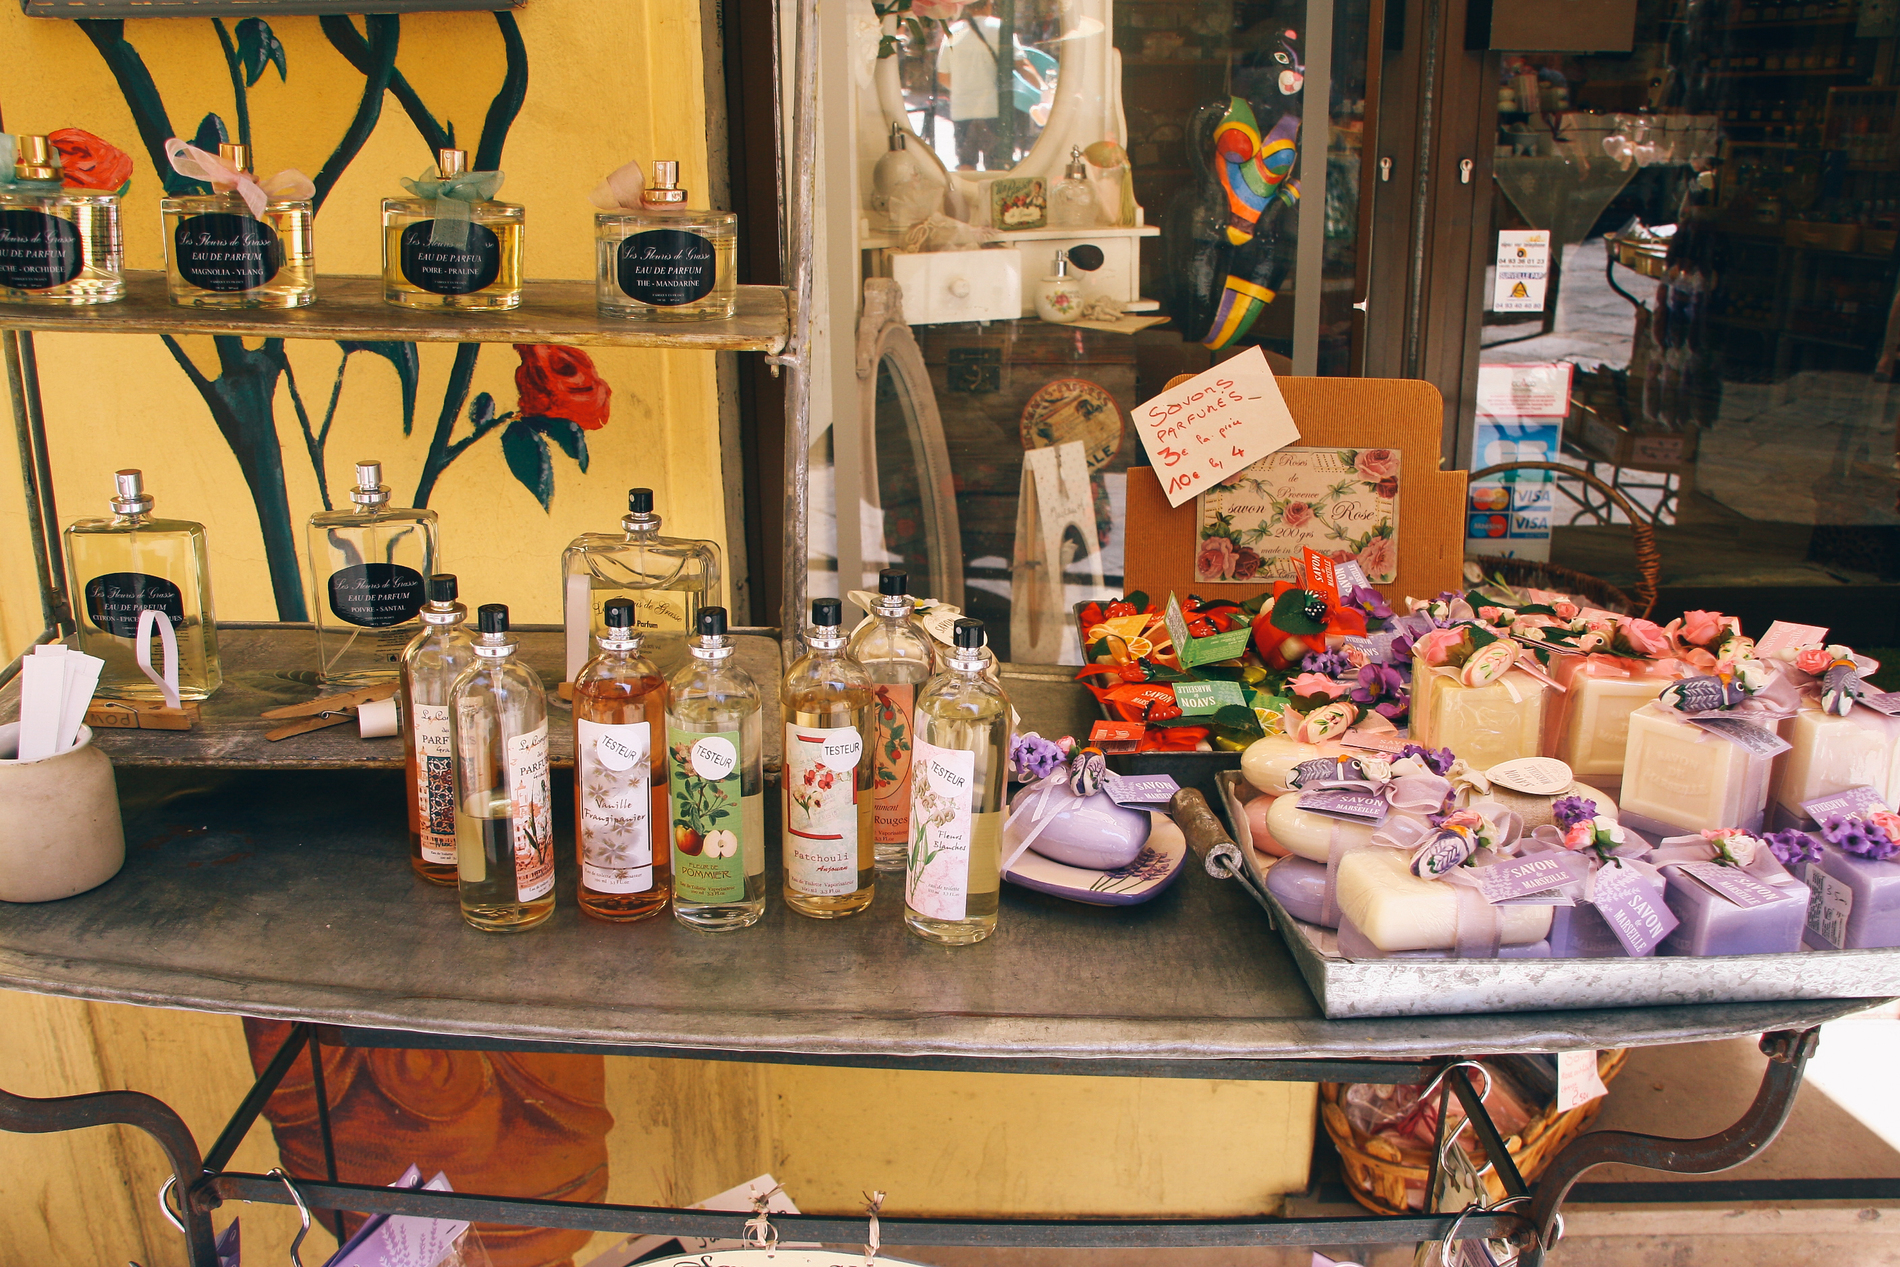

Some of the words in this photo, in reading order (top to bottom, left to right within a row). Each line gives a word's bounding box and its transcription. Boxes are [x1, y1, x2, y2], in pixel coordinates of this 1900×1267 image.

[31, 232, 41, 243] de
[44, 230, 76, 243] Grasse
[179, 231, 193, 246] Les
[229, 235, 239, 246] de
[242, 232, 272, 247] Grasse
[406, 232, 420, 246] Les
[25, 250, 66, 258] PARFUM
[192, 252, 209, 260] EAU
[224, 253, 262, 261] PARFUM
[418, 252, 434, 261] EAU
[436, 254, 448, 262] DE
[624, 246, 638, 259] Les
[673, 249, 683, 260] de
[685, 246, 710, 260] Grasse
[191, 268, 230, 276] MAGNOLIA
[236, 268, 264, 276] YLANG
[422, 266, 443, 274] POIRE
[635, 266, 653, 274] EAU
[654, 267, 666, 275] DE
[667, 266, 703, 275] PARFUM
[1231, 446, 1245, 457] 4
[1278, 453, 1308, 467] Roses
[1288, 473, 1299, 482] de
[1276, 486, 1319, 499] Provence
[1518, 490, 1550, 502] VISA
[1227, 502, 1266, 514] savon
[1331, 500, 1375, 521] Rose
[1516, 517, 1548, 529] VISA
[1274, 527, 1299, 538] 200
[1297, 531, 1314, 543] grs
[1261, 545, 1280, 554] made
[1311, 553, 1324, 583] SAVON
[1324, 559, 1335, 588] MARSEILLE
[333, 577, 349, 590] Les
[381, 579, 391, 589] de
[393, 575, 419, 588] Grasse
[136, 589, 146, 598] de
[147, 586, 176, 599] Grasse
[377, 592, 410, 601] PARFUM
[104, 603, 120, 611] EAU
[133, 603, 167, 611] PARFUM
[379, 604, 406, 612] SANTAL
[644, 599, 653, 610] de
[654, 601, 683, 622] Grasse
[637, 620, 658, 629] Parfum
[1177, 684, 1212, 694] MARSEILLE
[1141, 690, 1175, 703] SAVON
[1180, 695, 1216, 708] SAVON
[422, 735, 449, 745] PARF
[601, 734, 637, 761] TESTEUR
[824, 742, 860, 756] TESTEUR
[696, 744, 733, 768] TESTEUR
[931, 760, 966, 788] TESTEUR
[1135, 781, 1175, 791] SAVON
[595, 798, 632, 809] Vanille
[1339, 796, 1384, 807] SAVON
[1806, 798, 1849, 814] MARSEILLE
[1336, 804, 1380, 815] MARSEILLE
[584, 808, 646, 826] Frangipanier
[874, 815, 908, 827] Rouges
[938, 830, 962, 840] Fleurs
[933, 841, 966, 850] Blanches
[794, 850, 849, 863] Patchouli
[682, 867, 732, 880] POMMIER
[1510, 859, 1559, 878] SAVON
[1521, 871, 1570, 890] MARSEILLE
[1717, 880, 1761, 905] MARSEILLE
[1733, 878, 1779, 900] SAVON
[1627, 894, 1664, 939] SAVON
[1613, 908, 1647, 953] MARSEILLE
